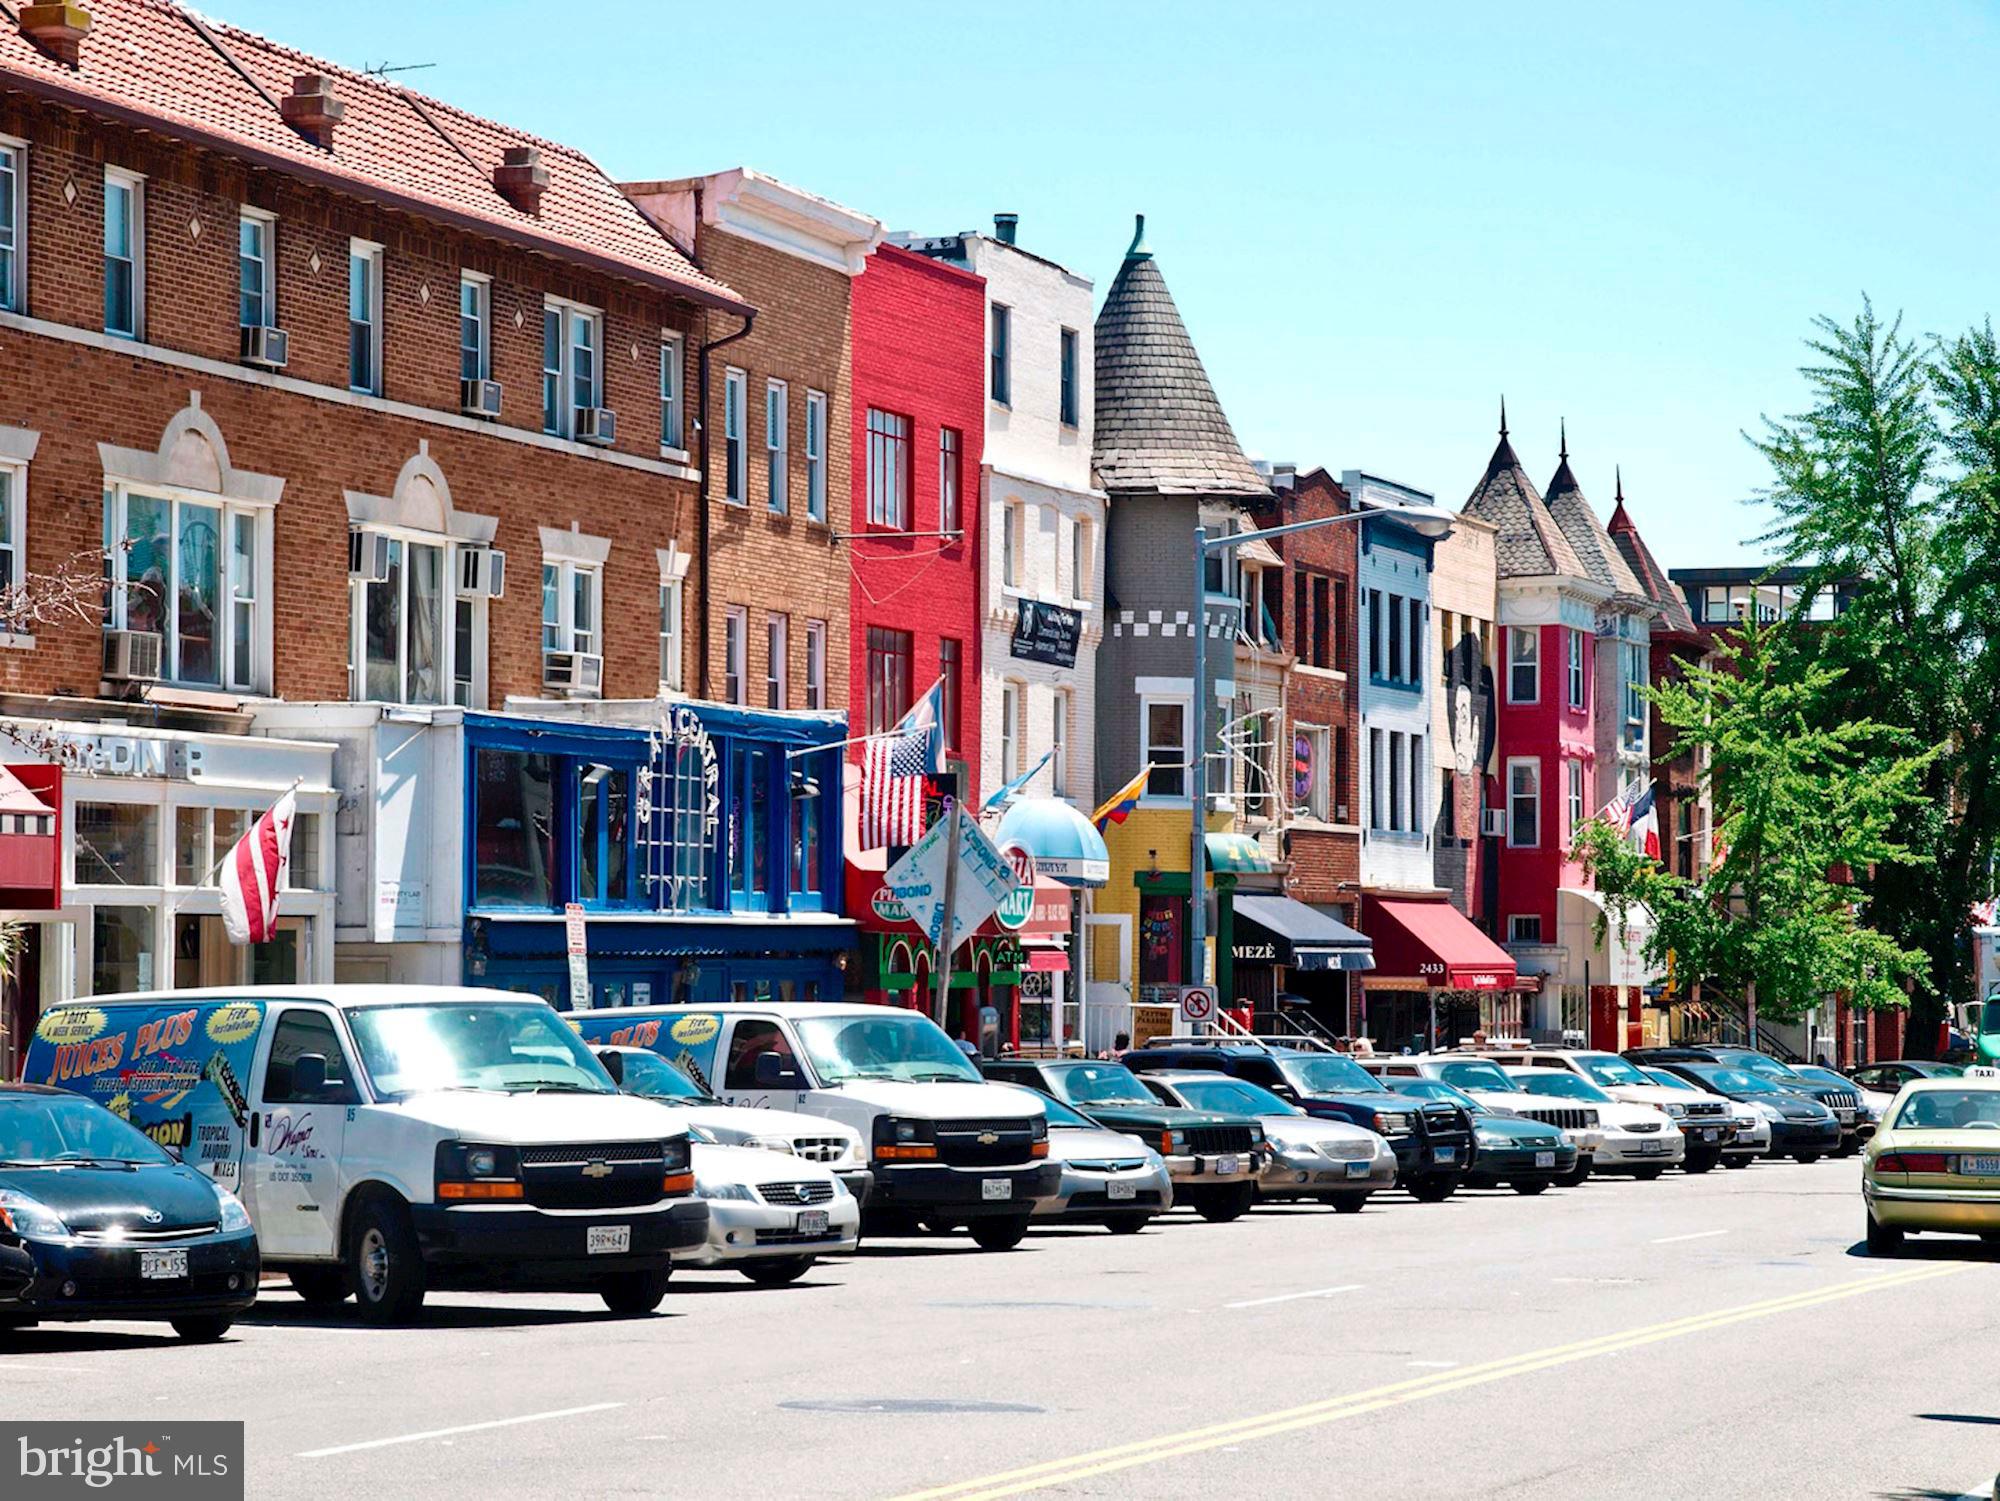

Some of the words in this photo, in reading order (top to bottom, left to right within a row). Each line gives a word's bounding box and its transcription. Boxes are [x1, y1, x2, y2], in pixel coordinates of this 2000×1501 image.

[877, 902, 909, 917] MAR
[996, 951, 1025, 963] ATM
[1419, 963, 1444, 974] 2433
[46, 1031, 127, 1087] JUICES
[130, 1009, 198, 1061] PLUS
[1974, 1069, 1995, 1078] TAXI
[197, 1125, 230, 1142] TROPICAL
[213, 1161, 236, 1177] MIXES
